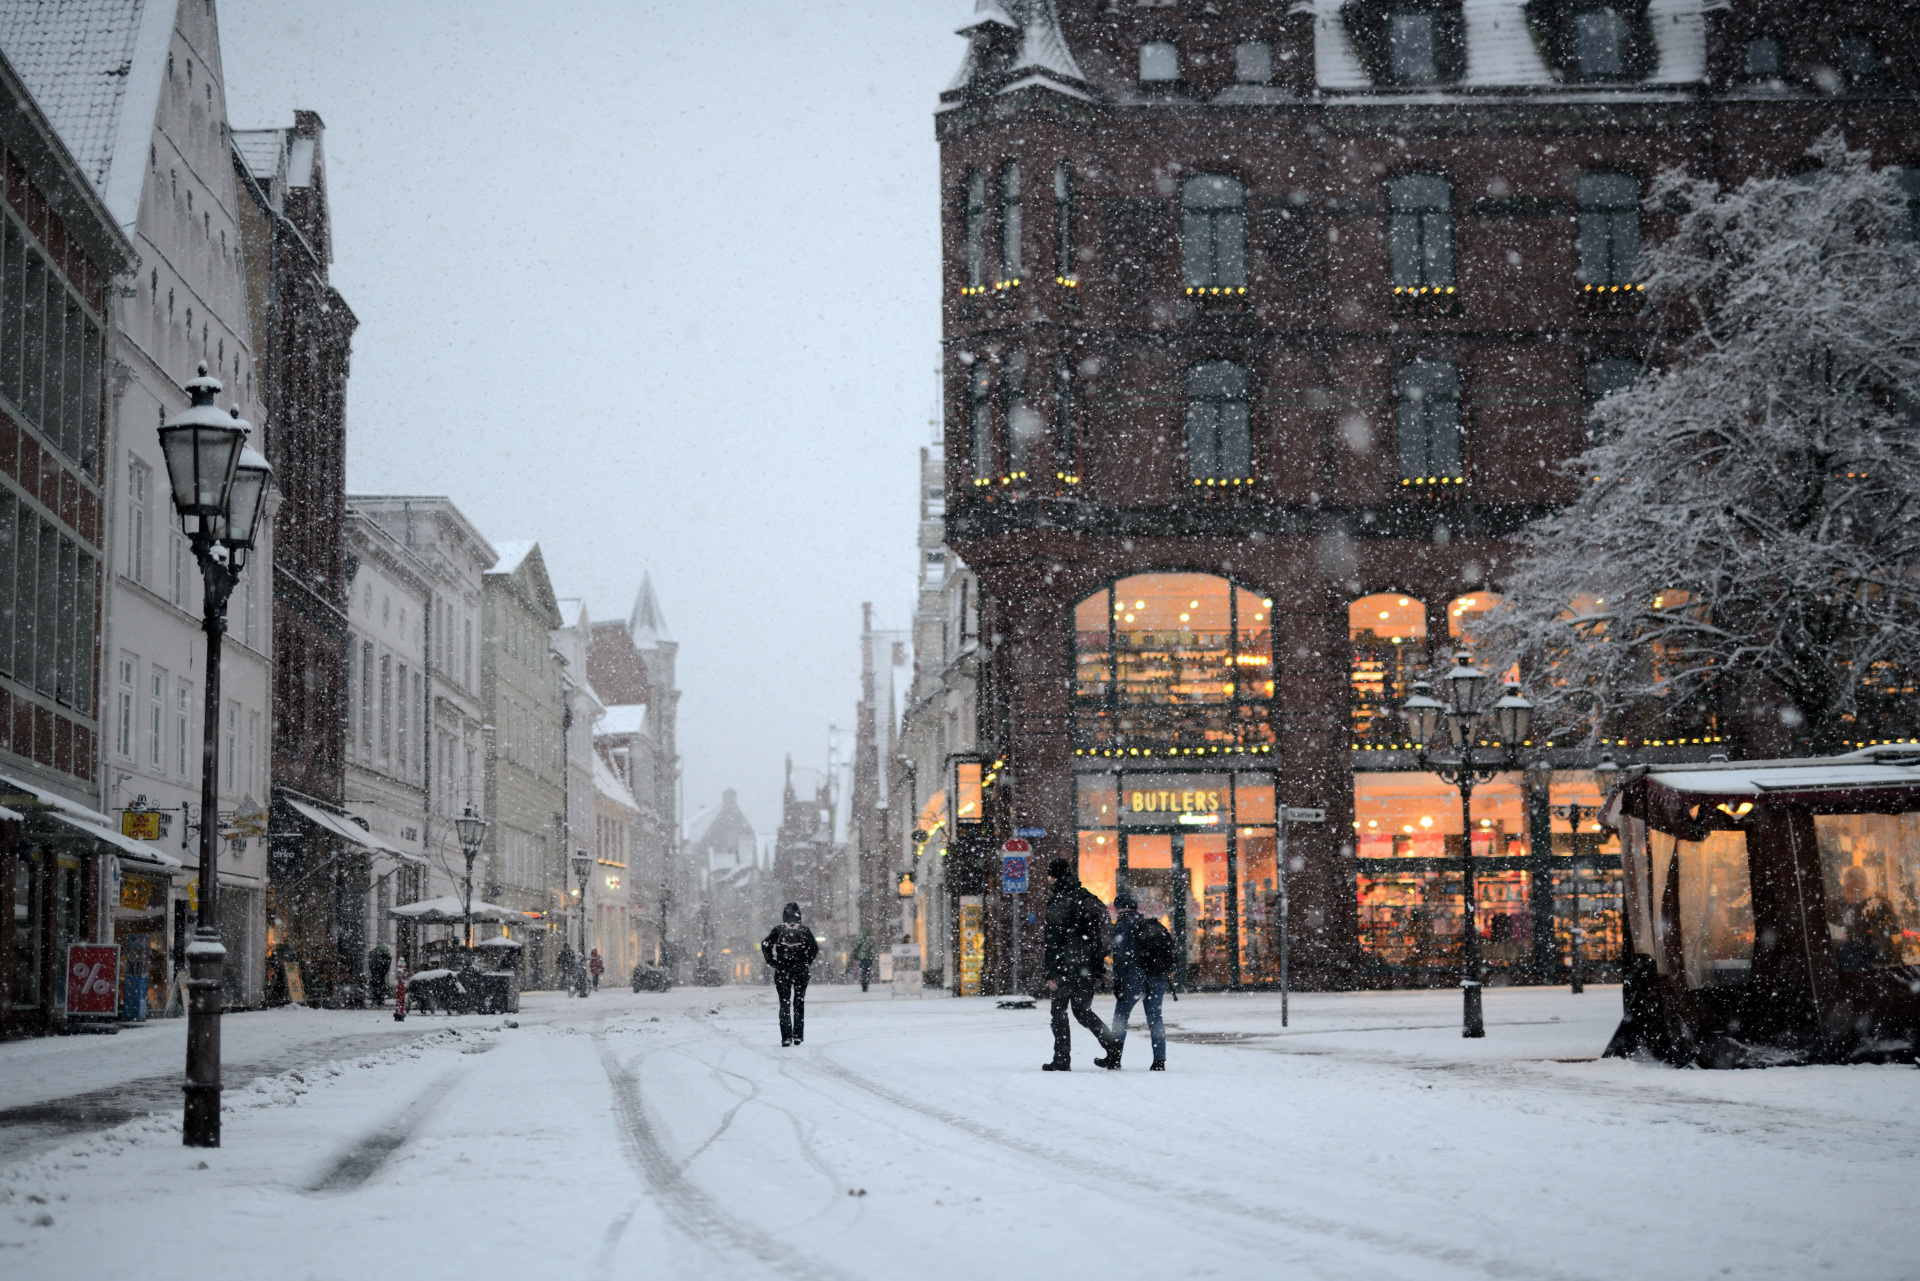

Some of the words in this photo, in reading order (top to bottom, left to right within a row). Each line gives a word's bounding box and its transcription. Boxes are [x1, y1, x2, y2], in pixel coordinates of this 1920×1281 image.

[1132, 791, 1219, 812] BUTLERS
[1006, 881, 1025, 890] TAXI
[73, 962, 110, 995] %
